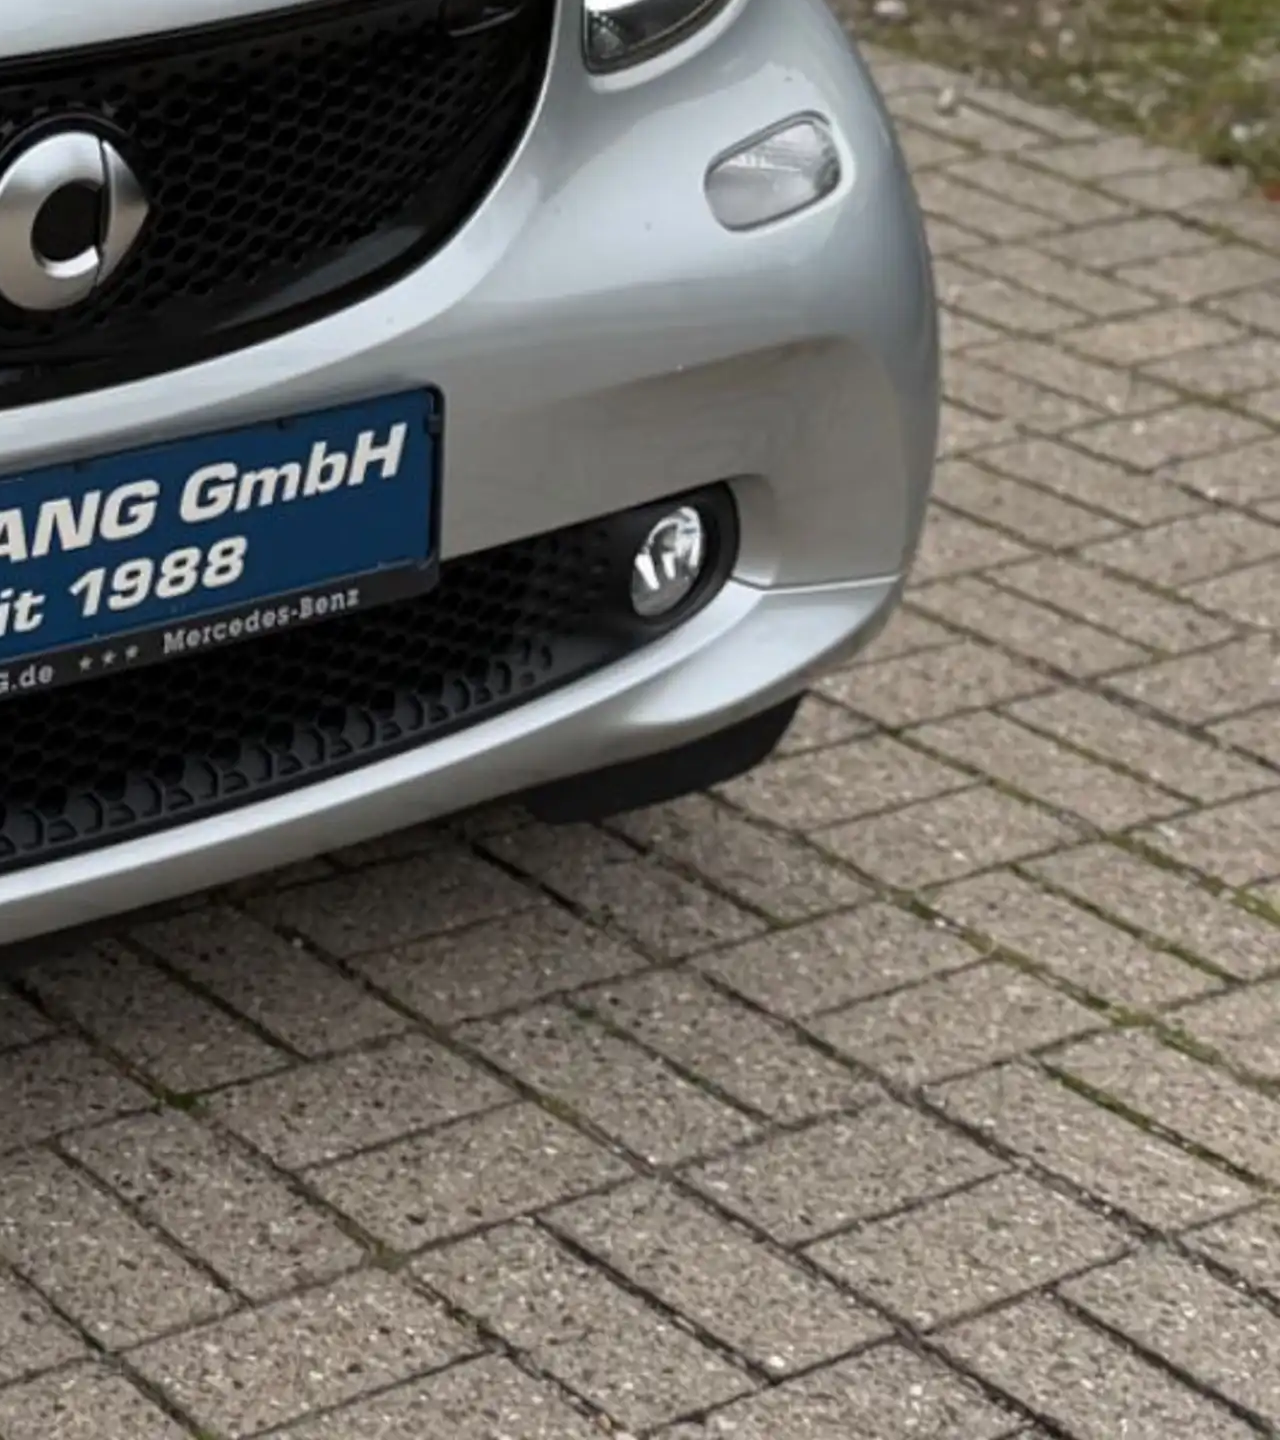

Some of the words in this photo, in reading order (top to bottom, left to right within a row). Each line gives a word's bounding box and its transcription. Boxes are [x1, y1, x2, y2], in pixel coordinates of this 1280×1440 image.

[179, 422, 407, 524] GmbH
[68, 535, 247, 618] 1988
[163, 588, 360, 654] Mercedes-Benz
